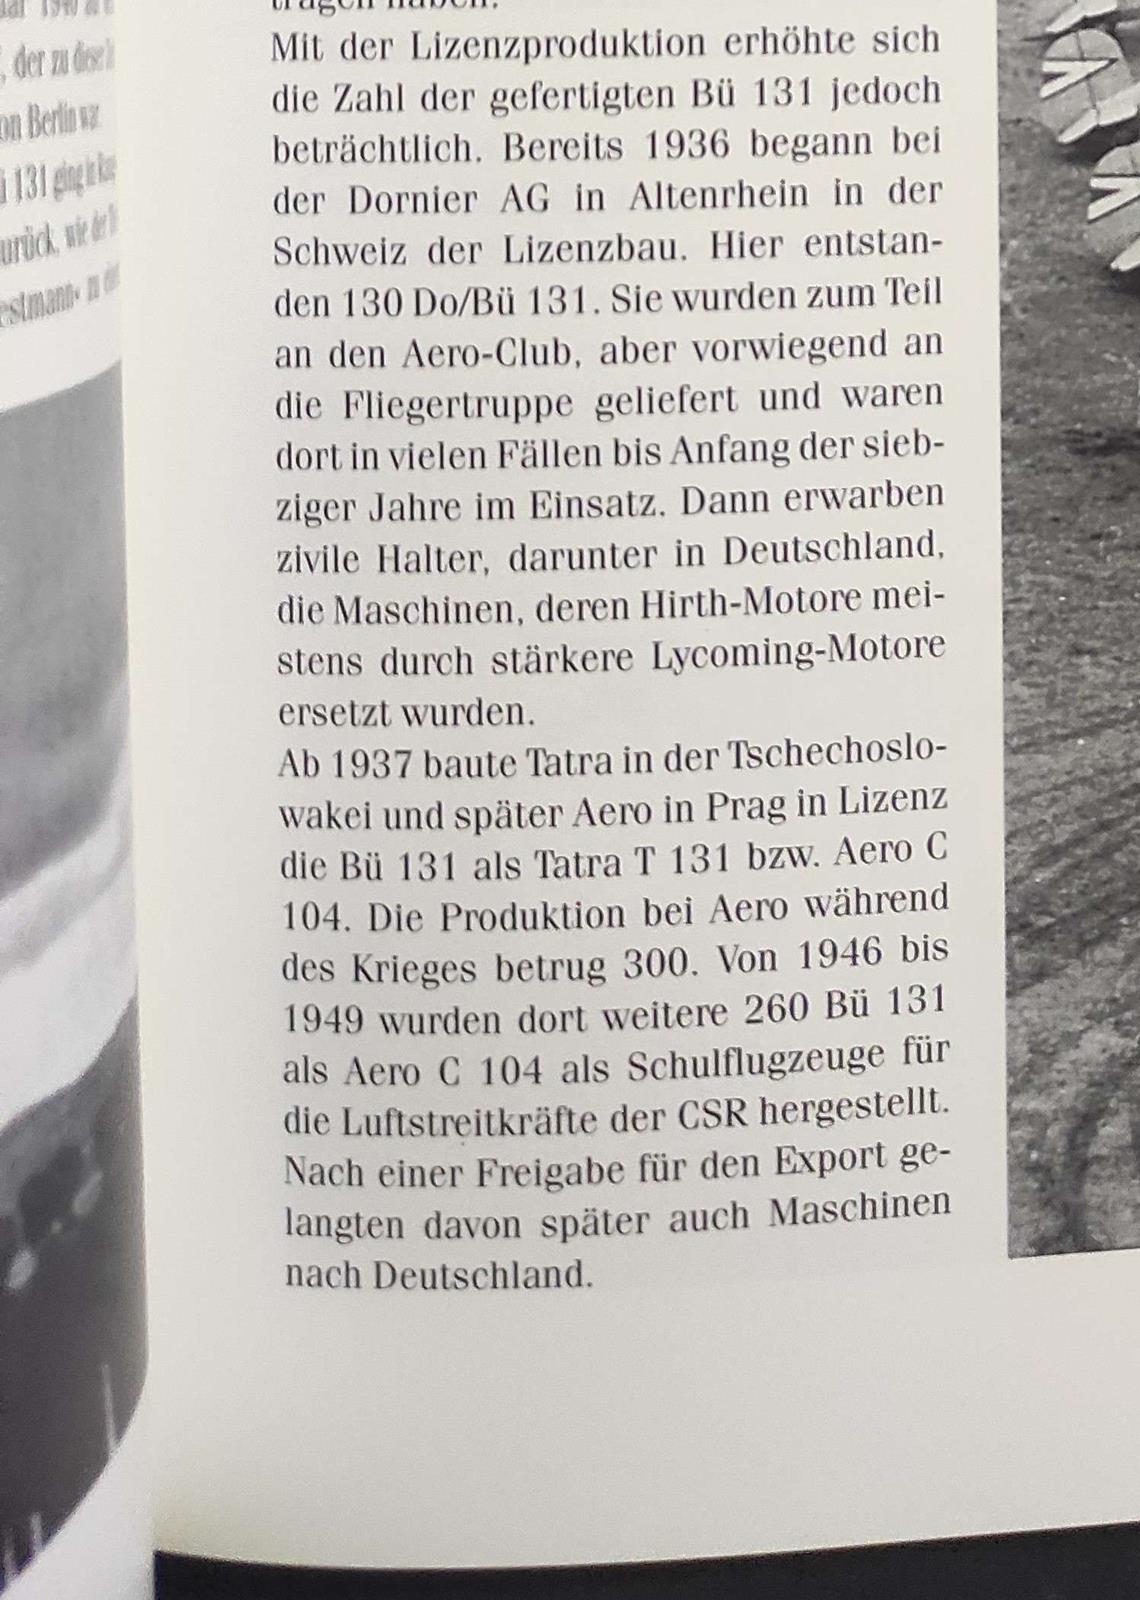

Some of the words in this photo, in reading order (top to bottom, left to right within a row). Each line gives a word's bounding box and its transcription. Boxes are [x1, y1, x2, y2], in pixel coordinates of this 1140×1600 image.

[272, 32, 323, 62] Mit
[340, 31, 393, 61] der
[412, 28, 705, 66] Lizenzproduktion
[725, 26, 855, 56] erhöhte
[873, 24, 939, 53] sich
[273, 133, 481, 164] beträchtlich.
[504, 132, 623, 162] Bereits
[647, 128, 729, 160] 1936
[751, 128, 872, 163] begann
[893, 126, 940, 154] bei
[274, 236, 406, 266] Schweiz
[428, 236, 482, 265] der
[504, 233, 686, 264] Lizenzbau.
[712, 230, 783, 259] Hier
[805, 229, 943, 257] entstan-
[276, 390, 321, 420] die
[344, 390, 573, 426] Fliegertruppe
[595, 384, 738, 422] geliefert
[760, 381, 820, 411] und
[841, 383, 942, 408] waren
[277, 493, 356, 528] ziger
[369, 492, 461, 522] Jahre
[476, 492, 515, 520] im
[530, 490, 665, 519] Einsatz.
[682, 486, 769, 515] Dann
[785, 479, 943, 511] erwarben
[277, 545, 359, 574] zivile
[378, 544, 489, 576] Halter,
[509, 543, 657, 572] darunter
[676, 539, 704, 567] in
[724, 528, 943, 565] Deutschland,
[278, 648, 362, 676] stens
[381, 646, 473, 676] durch
[492, 644, 633, 675] stärkere
[653, 633, 945, 676] Lycoming-Motore
[279, 700, 392, 727] ersetzt
[401, 697, 534, 728] wurden.
[279, 800, 371, 830] wakei
[384, 801, 444, 830] und
[455, 800, 563, 836] später
[572, 797, 652, 827] Aero
[665, 795, 694, 823] in
[707, 792, 786, 825] Prag
[798, 789, 826, 817] in
[839, 786, 948, 815] Lizenz
[282, 952, 334, 982] des
[353, 954, 476, 990] Krieges
[496, 953, 606, 987] betrug
[624, 947, 698, 979] 300.
[717, 944, 777, 973] Von
[800, 936, 882, 969] 1946
[901, 934, 948, 963] bis
[284, 1105, 330, 1135] die
[343, 1105, 597, 1138] Luftstreitkräfte
[611, 1104, 666, 1133] der
[678, 1098, 748, 1130] CSR
[760, 1086, 948, 1128] hergestellt.
[286, 1207, 404, 1245] langten
[424, 1210, 521, 1240] davon
[541, 1208, 650, 1244] später
[670, 1201, 749, 1233] auch
[769, 1191, 951, 1227] Maschinen
[286, 1260, 362, 1289] nach
[374, 1259, 592, 1290] Deutschland.
